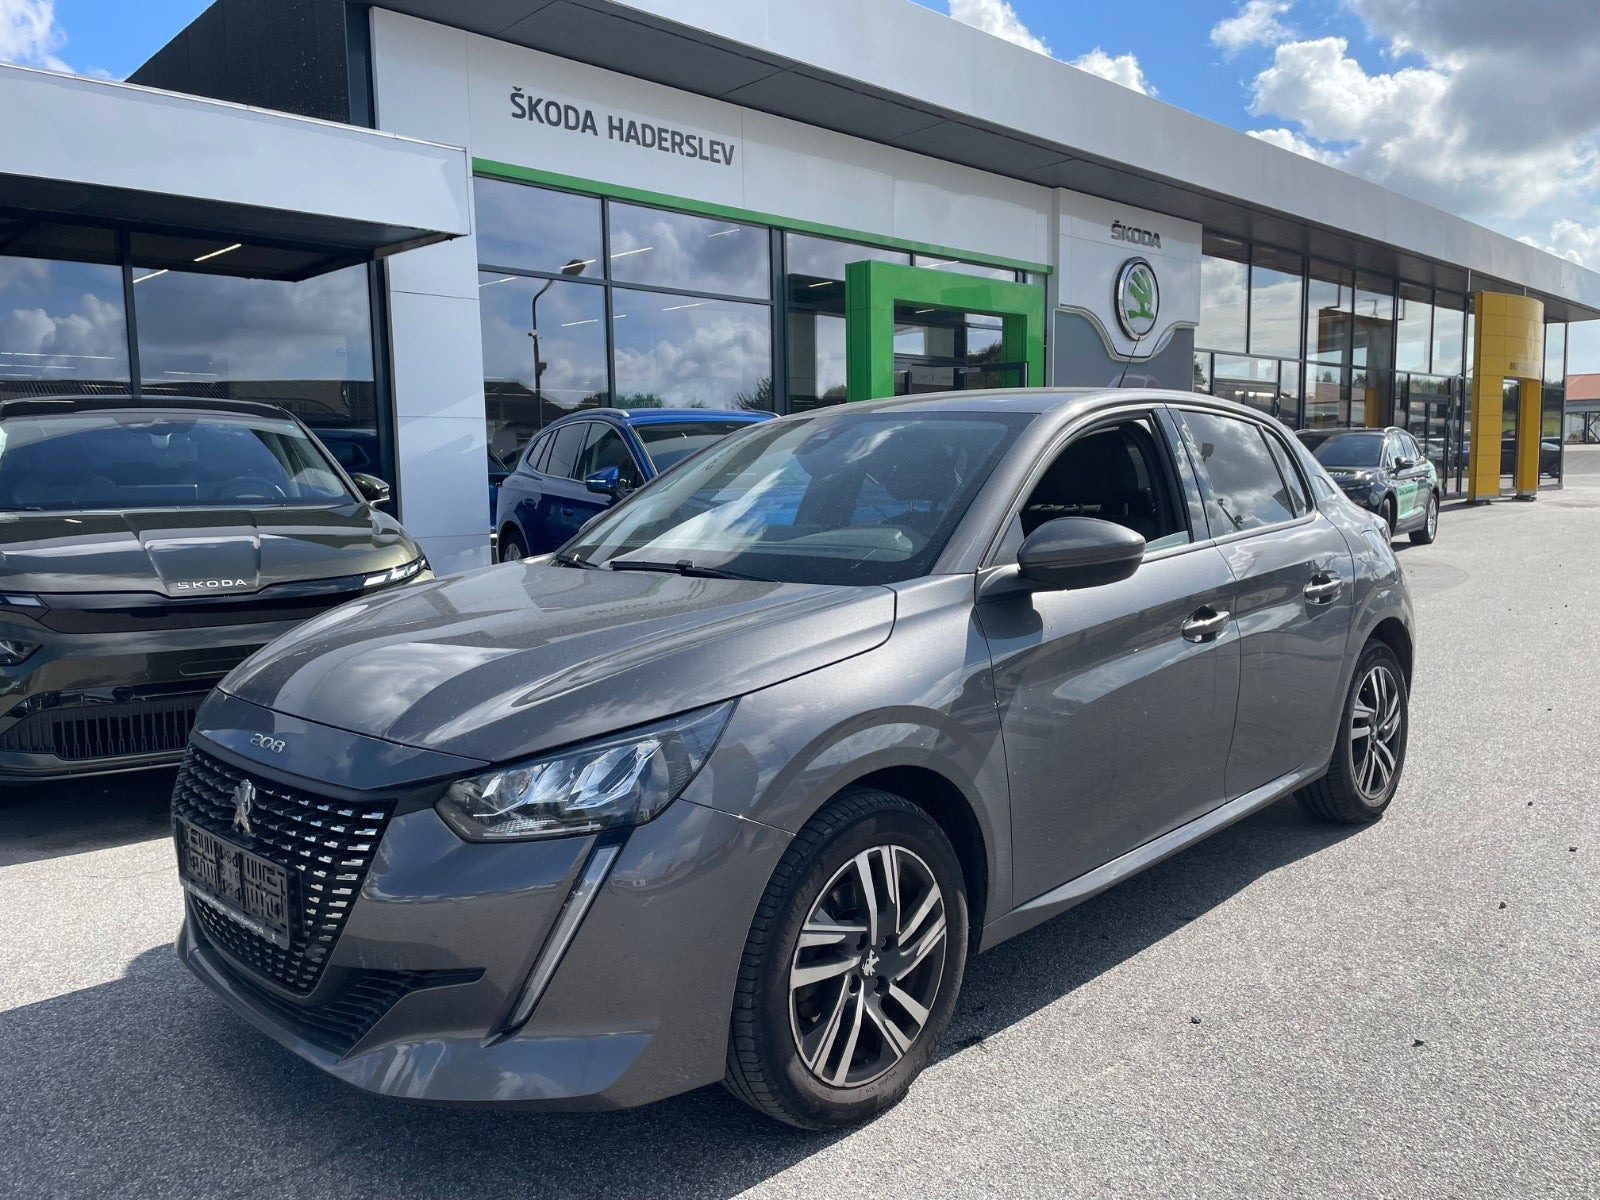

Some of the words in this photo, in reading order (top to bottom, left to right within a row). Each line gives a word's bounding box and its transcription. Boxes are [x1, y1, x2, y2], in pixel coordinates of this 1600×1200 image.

[509, 86, 599, 137] ŠKODA
[607, 115, 736, 166] HADERSLEV
[1110, 219, 1162, 249] ŠKODA
[250, 732, 286, 754] 208
